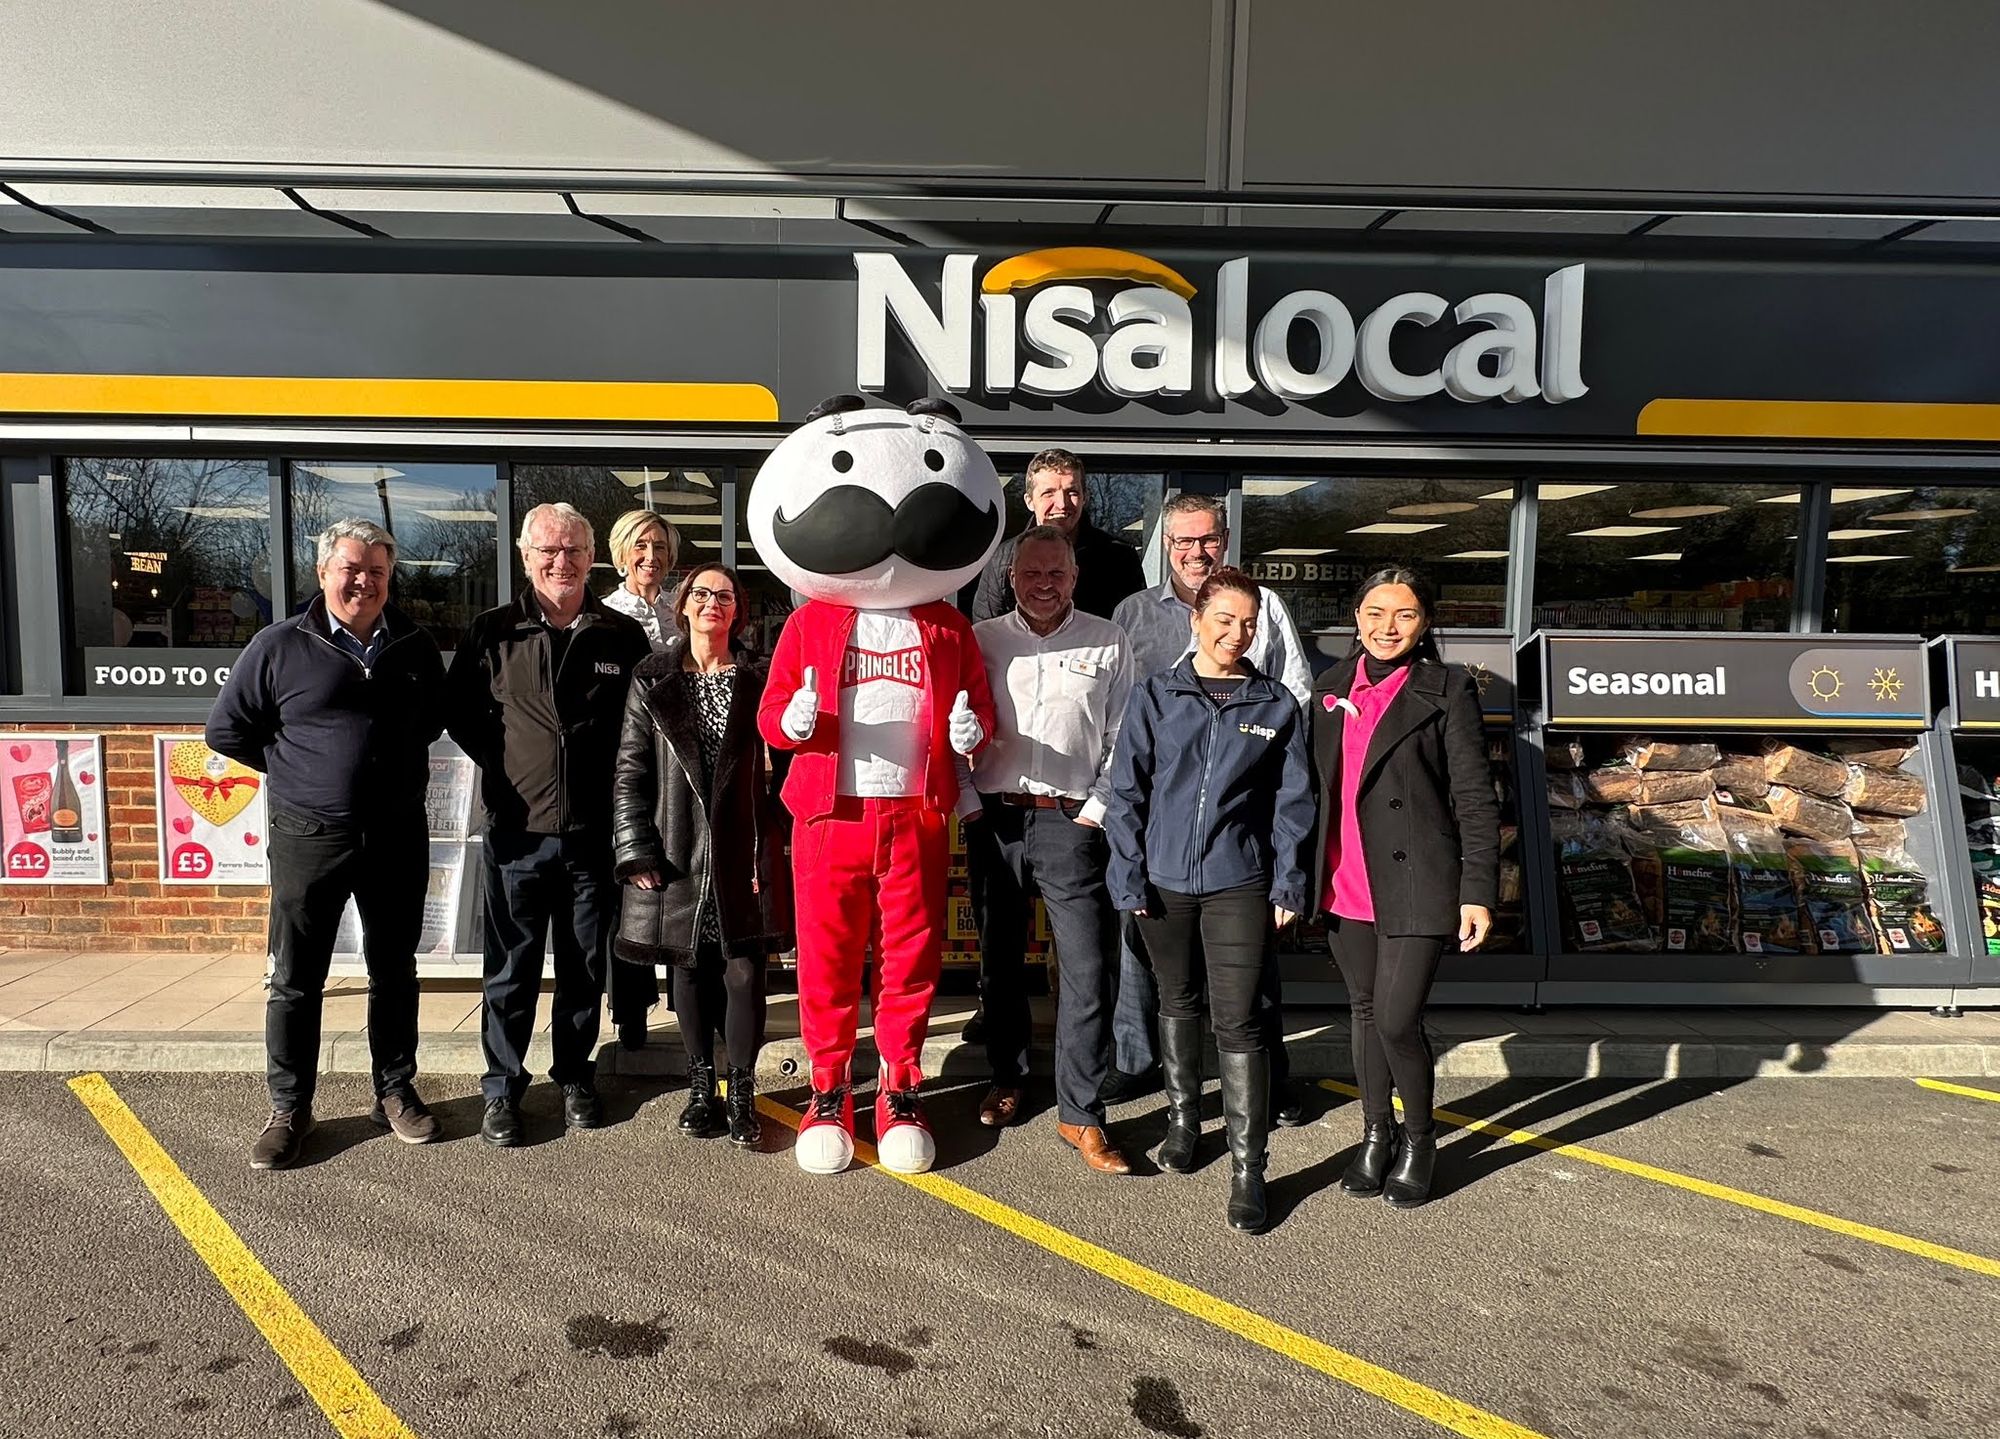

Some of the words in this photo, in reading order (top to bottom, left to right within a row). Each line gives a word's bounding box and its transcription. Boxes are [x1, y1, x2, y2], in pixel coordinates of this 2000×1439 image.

[1302, 563, 1366, 581] BEER
[94, 666, 166, 686] FOOD
[171, 666, 208, 686] TO
[213, 667, 232, 686] G
[594, 662, 621, 675] Nisa
[844, 650, 922, 684] PRINGLES
[1568, 666, 1726, 695] Seasonal
[1975, 671, 2000, 697] H
[1249, 724, 1277, 741] Jisp
[10, 853, 46, 869] £12
[52, 847, 76, 858] Bubbly
[178, 852, 208, 872] £5
[957, 906, 975, 918] FU
